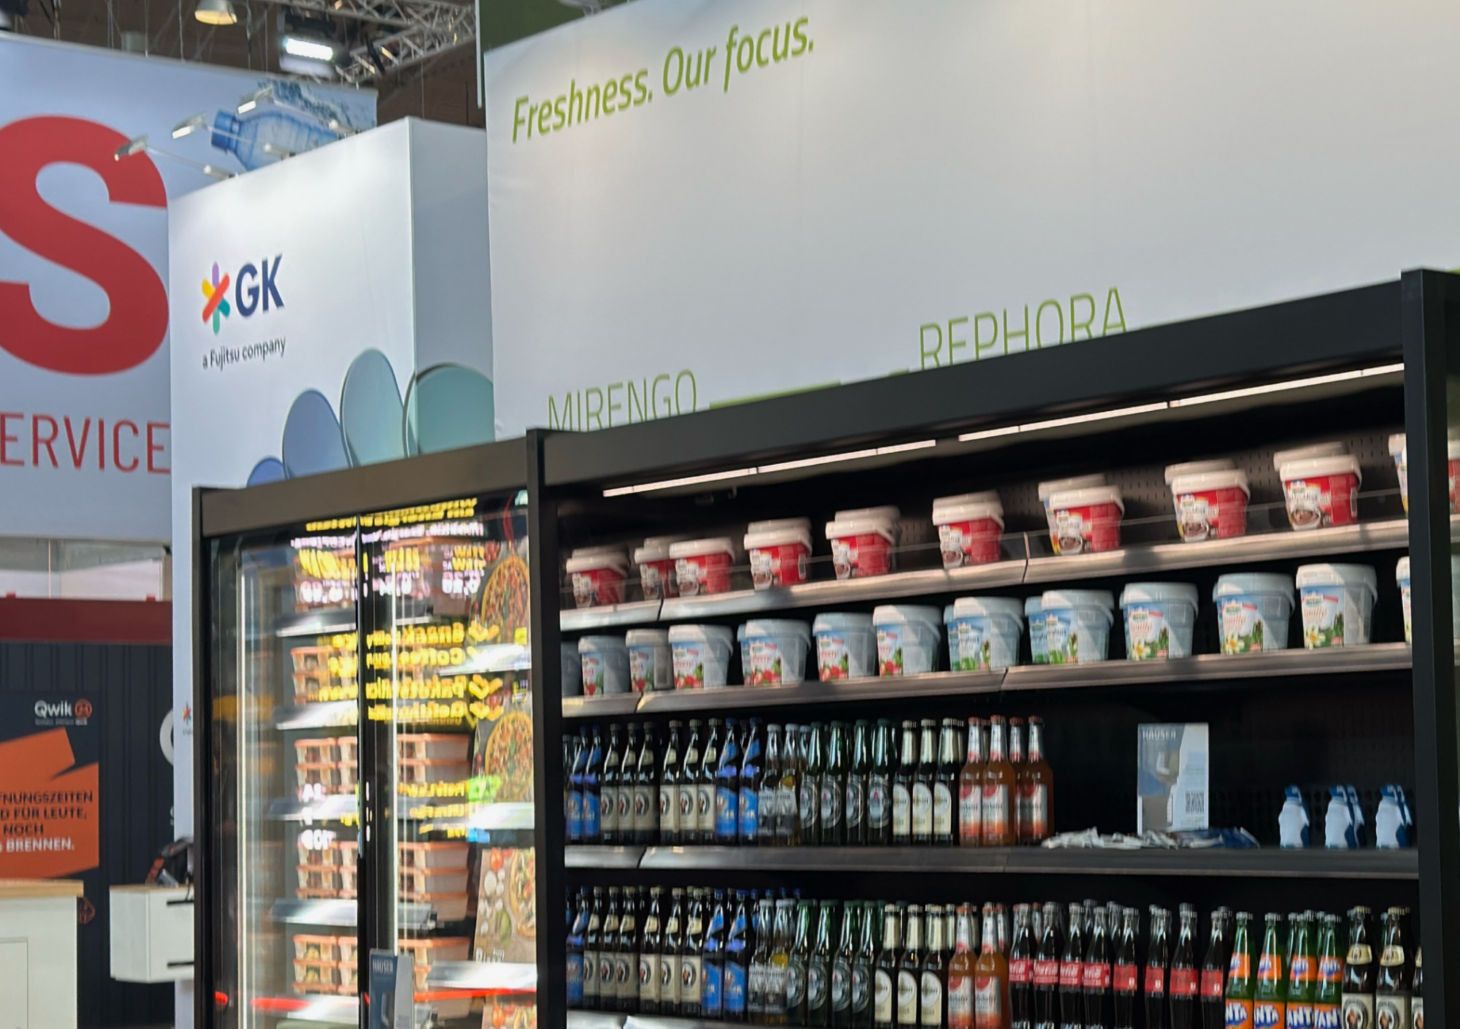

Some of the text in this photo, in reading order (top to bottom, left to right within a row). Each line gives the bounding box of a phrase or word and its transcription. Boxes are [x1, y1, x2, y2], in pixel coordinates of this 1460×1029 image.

[512, 17, 815, 144] Freshness. Our focus.
[0, 115, 169, 376] S
[235, 252, 285, 319] GK
[202, 336, 287, 371] a Fujitsu company
[34, 700, 72, 718] Qwik
[3, 823, 44, 836] NOCH
[6, 838, 75, 852] BRENNEN.
[1225, 1003, 1248, 1024] NTA
